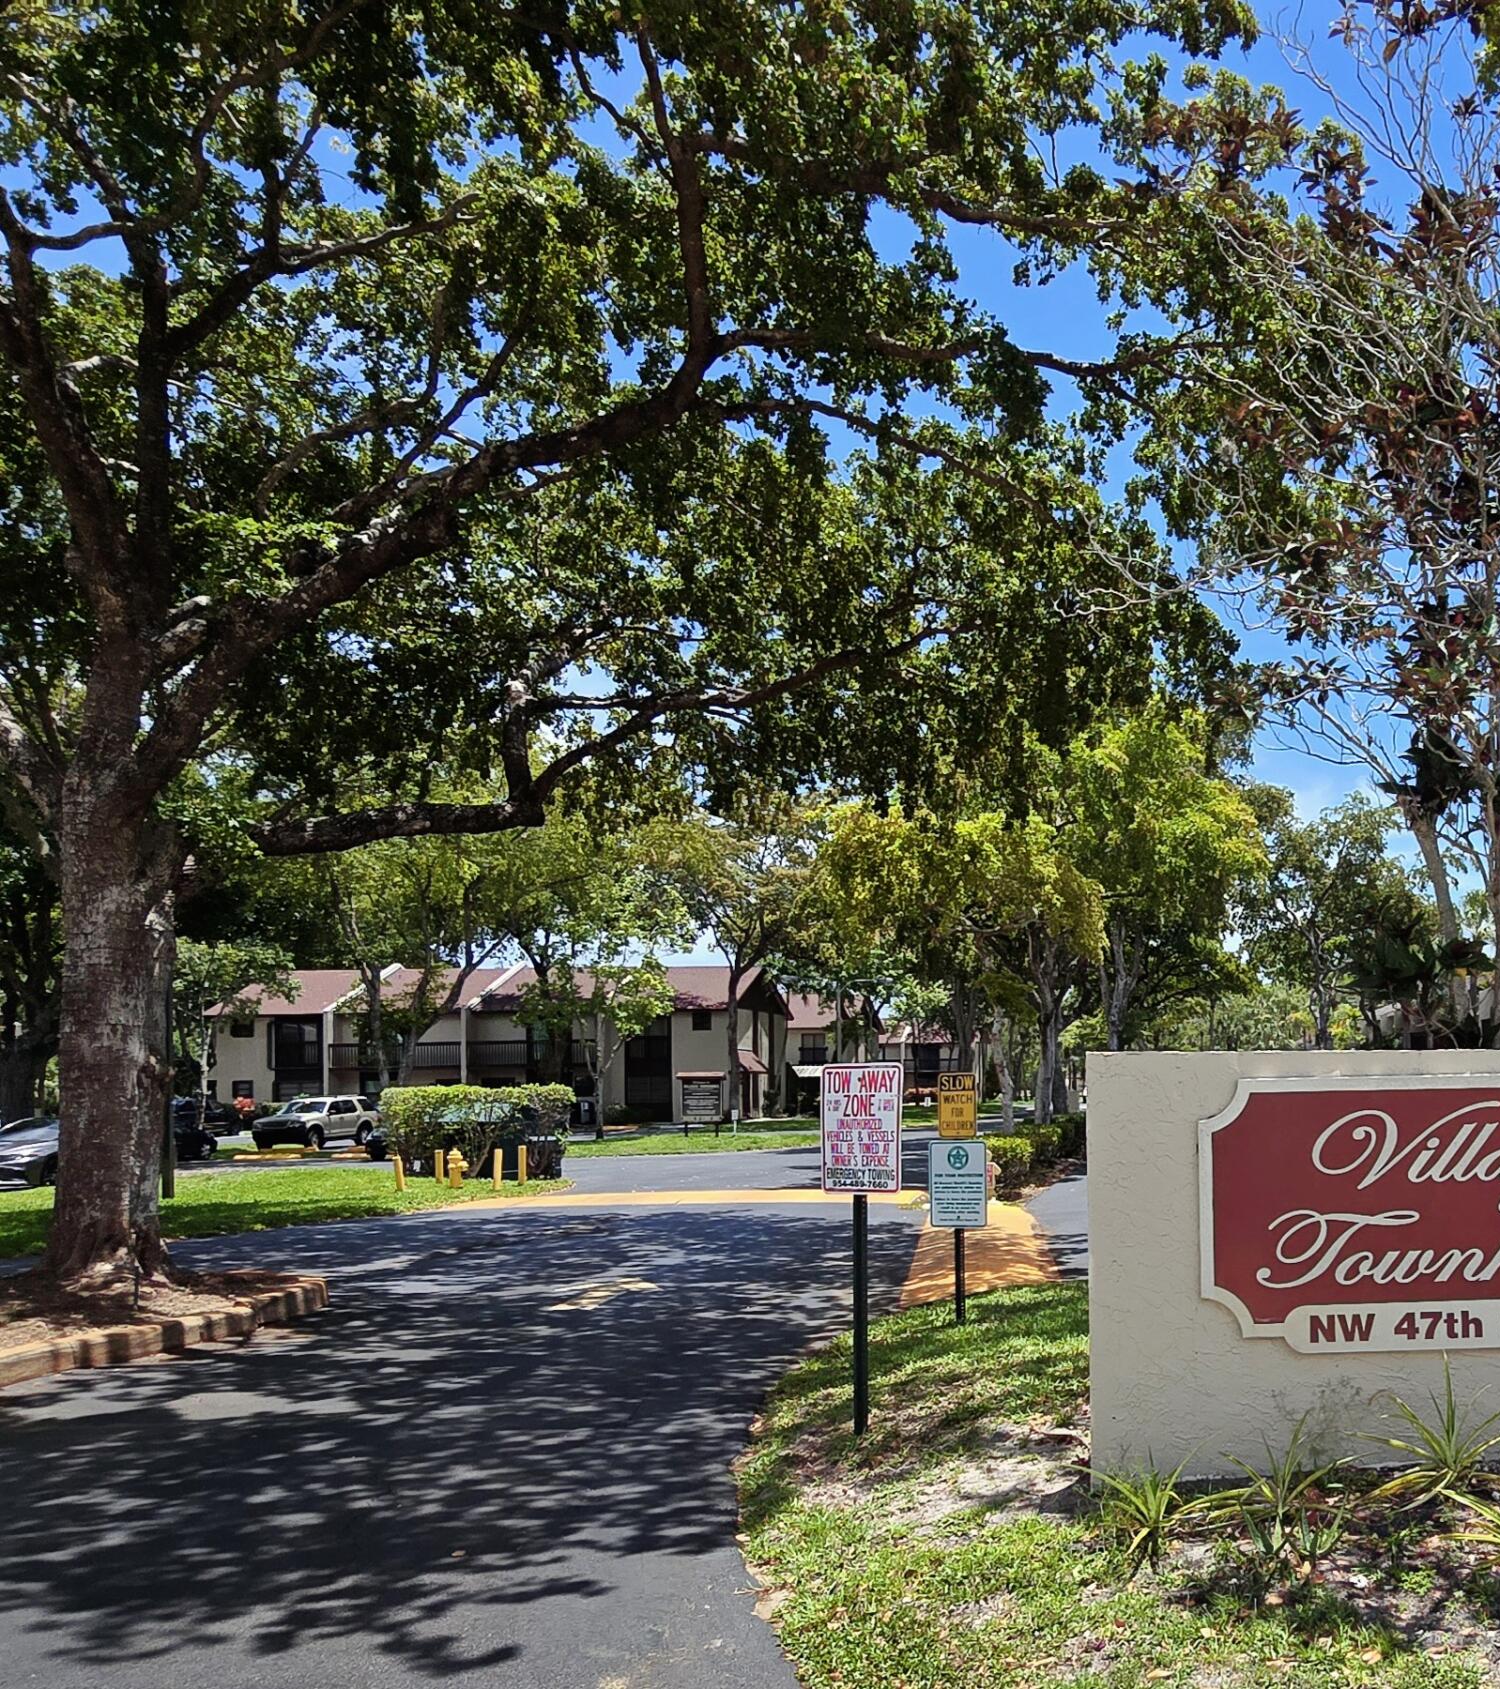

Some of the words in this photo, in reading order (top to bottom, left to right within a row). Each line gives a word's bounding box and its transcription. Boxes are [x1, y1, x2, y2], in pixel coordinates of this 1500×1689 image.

[827, 1071, 851, 1093] TOW
[859, 1070, 896, 1093] AWAY
[941, 1075, 974, 1090] SLOW
[943, 1094, 973, 1104] WATCH
[843, 1094, 875, 1117] ZONE
[951, 1107, 964, 1118] FOR
[837, 1119, 882, 1130] UNAUTHORIZED
[942, 1121, 974, 1130] CHILDREN
[827, 1131, 853, 1142] VEHICLES
[858, 1131, 863, 1142] &
[867, 1131, 895, 1142] VESSELS
[831, 1143, 843, 1154] WILL
[847, 1143, 855, 1154] BE
[859, 1143, 879, 1154] TOWED
[882, 1143, 889, 1154] AT
[861, 1155, 889, 1167] EXPENSE
[827, 1168, 866, 1180] EMERGENCY
[868, 1169, 895, 1181] TOWING
[1309, 1313, 1376, 1343] NW
[1394, 1309, 1484, 1341] 47th
